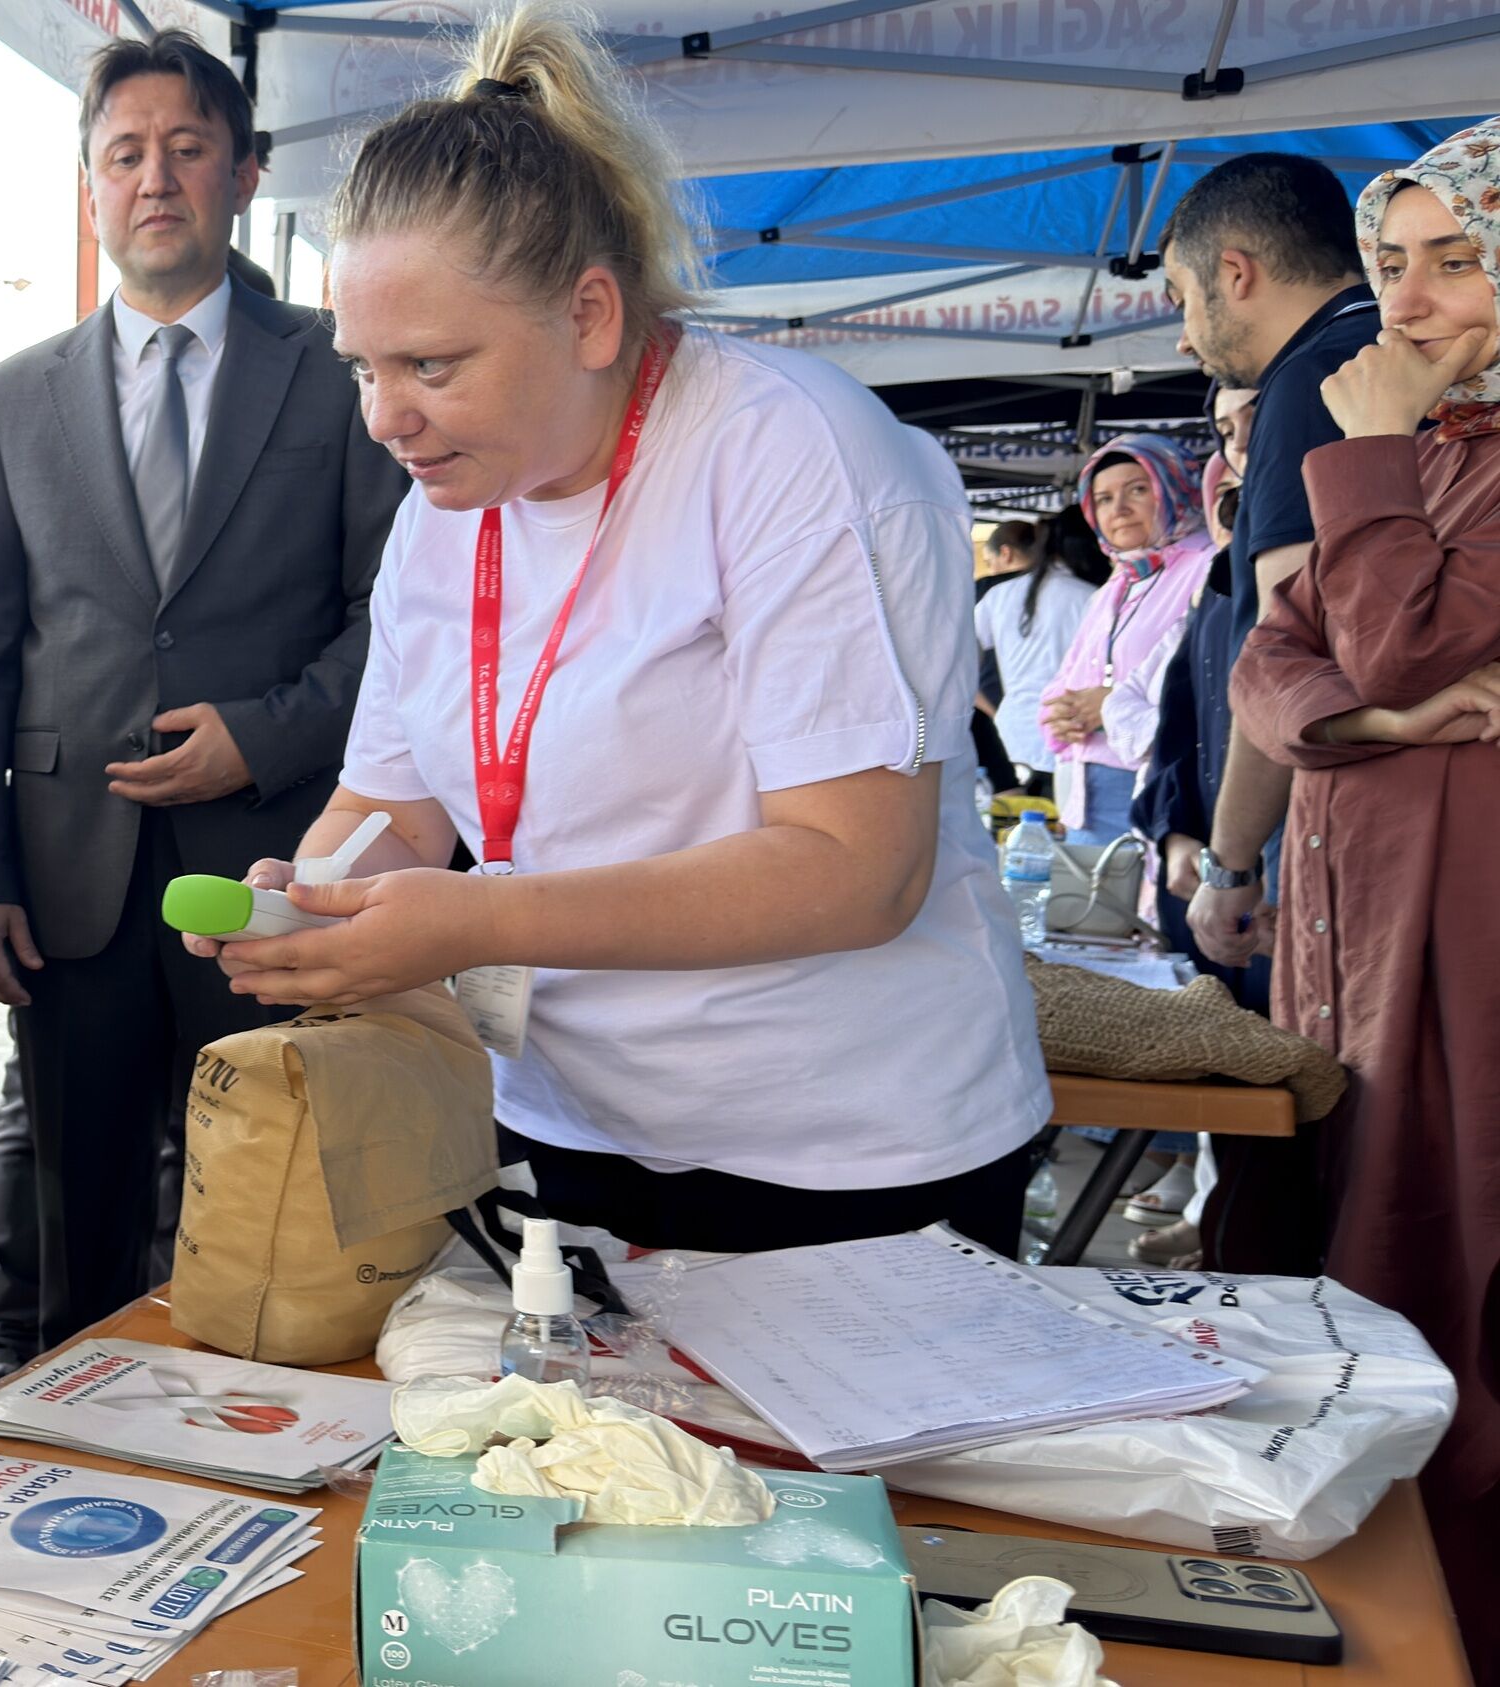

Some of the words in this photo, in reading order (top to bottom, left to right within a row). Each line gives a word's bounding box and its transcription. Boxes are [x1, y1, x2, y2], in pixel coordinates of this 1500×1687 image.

[17, 1351, 106, 1396] koruyalım
[36, 1355, 135, 1402] Sağlığımızı
[0, 1466, 76, 1506] SİGARA
[375, 1503, 524, 1519] GLOVES
[370, 1519, 454, 1532] PLATIN
[169, 1582, 201, 1602] ALO
[747, 1588, 853, 1614] PLATIN
[150, 1601, 186, 1617] 171
[383, 1614, 405, 1631] M
[663, 1613, 853, 1653] GLOVES
